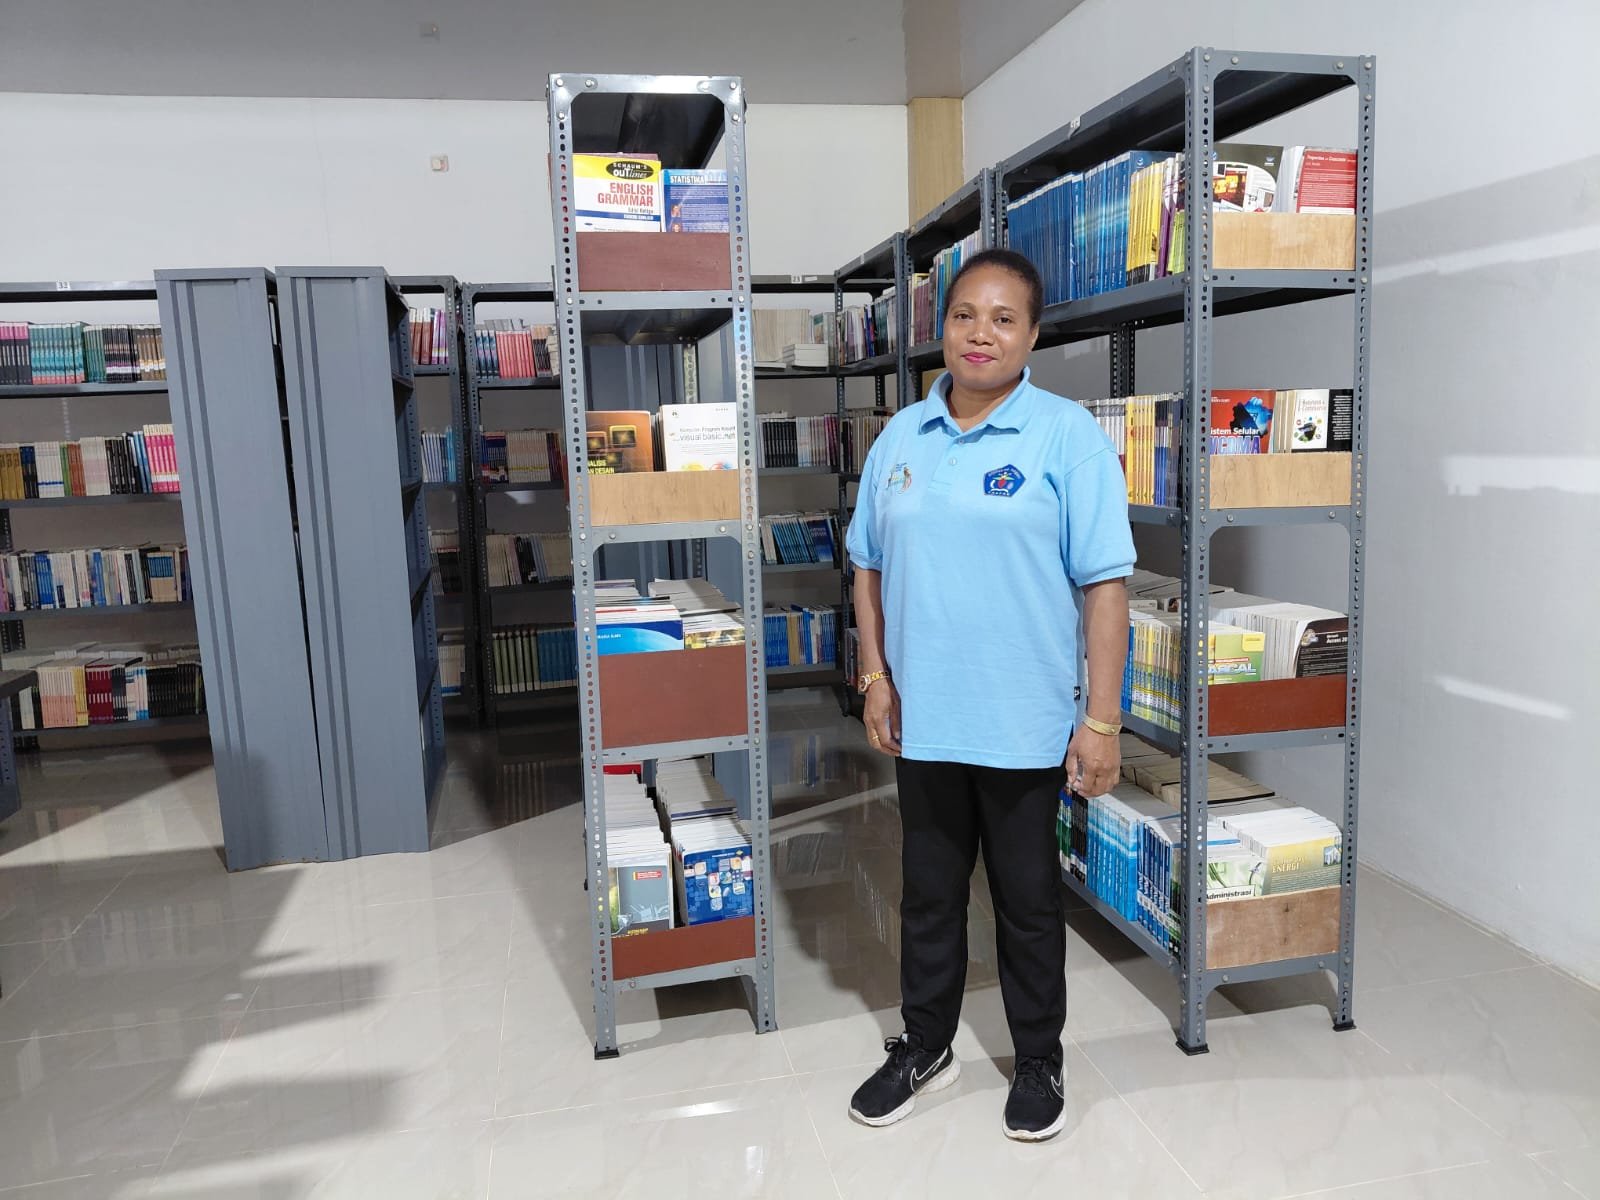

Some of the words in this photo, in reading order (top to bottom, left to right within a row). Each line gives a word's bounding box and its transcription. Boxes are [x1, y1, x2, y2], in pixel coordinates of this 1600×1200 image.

[609, 182, 654, 196] ENGLISH
[597, 192, 654, 207] GRAMMAR
[1210, 427, 1232, 435] istem
[1233, 427, 1259, 435] Selular
[1208, 663, 1257, 675] ASCAL
